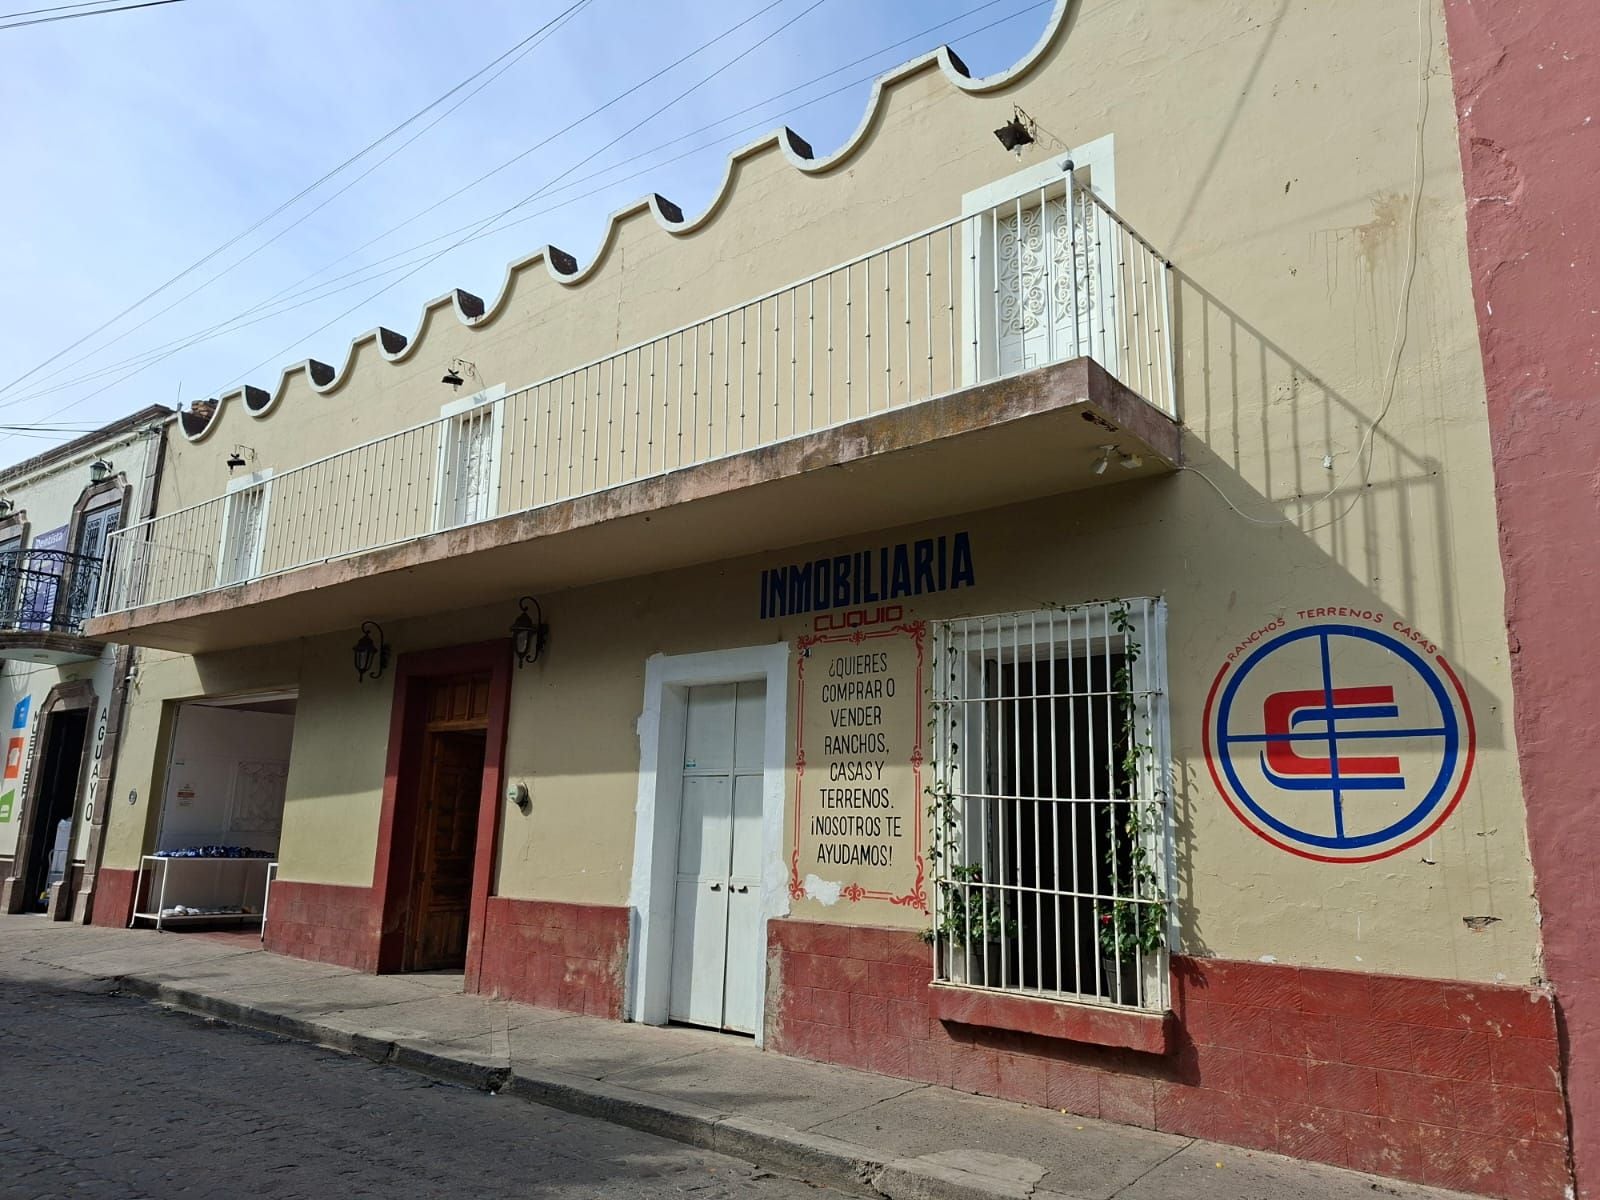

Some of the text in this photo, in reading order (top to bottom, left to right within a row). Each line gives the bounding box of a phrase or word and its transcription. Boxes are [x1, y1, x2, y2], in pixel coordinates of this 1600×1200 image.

[760, 531, 975, 619] INMOBILIARIA
[1227, 606, 1438, 662] RANCHOS TERRENOS CASAS
[828, 652, 887, 677] ¿QUIERES
[822, 678, 895, 703] COMPRAR O
[830, 706, 882, 727] VENDER
[824, 733, 890, 755] RANCHOS,
[85, 707, 107, 821] AGUAYO
[830, 761, 885, 782] CASAS Y
[820, 788, 894, 809] TERRENOS.
[811, 815, 902, 837] ¡NOSOTROS TE
[817, 843, 893, 866] AYUDAMOS!
